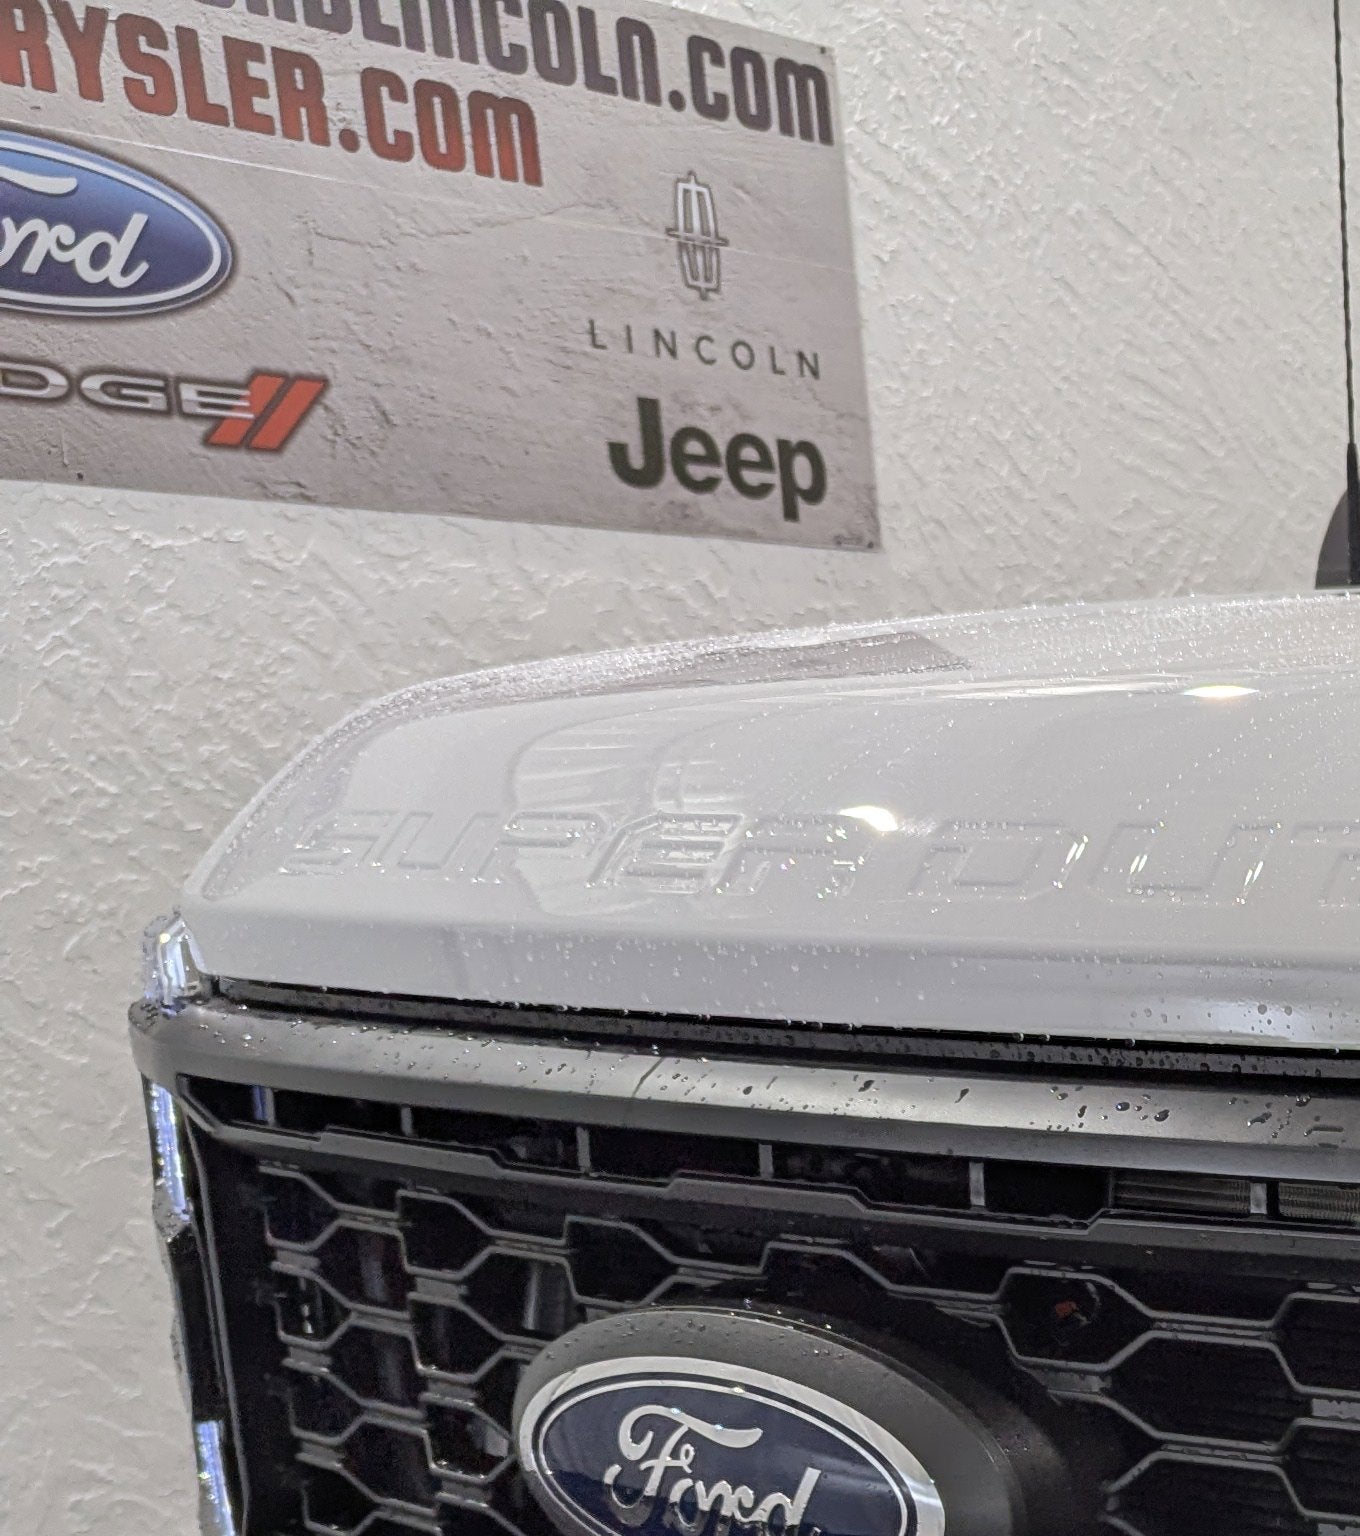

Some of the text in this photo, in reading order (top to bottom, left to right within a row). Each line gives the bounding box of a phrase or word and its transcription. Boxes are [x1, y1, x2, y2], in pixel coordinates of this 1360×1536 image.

[0, 164, 150, 289] rd
[588, 318, 821, 380] LINCOLN
[607, 396, 827, 522] Jeep
[278, 808, 876, 900] SUPER
